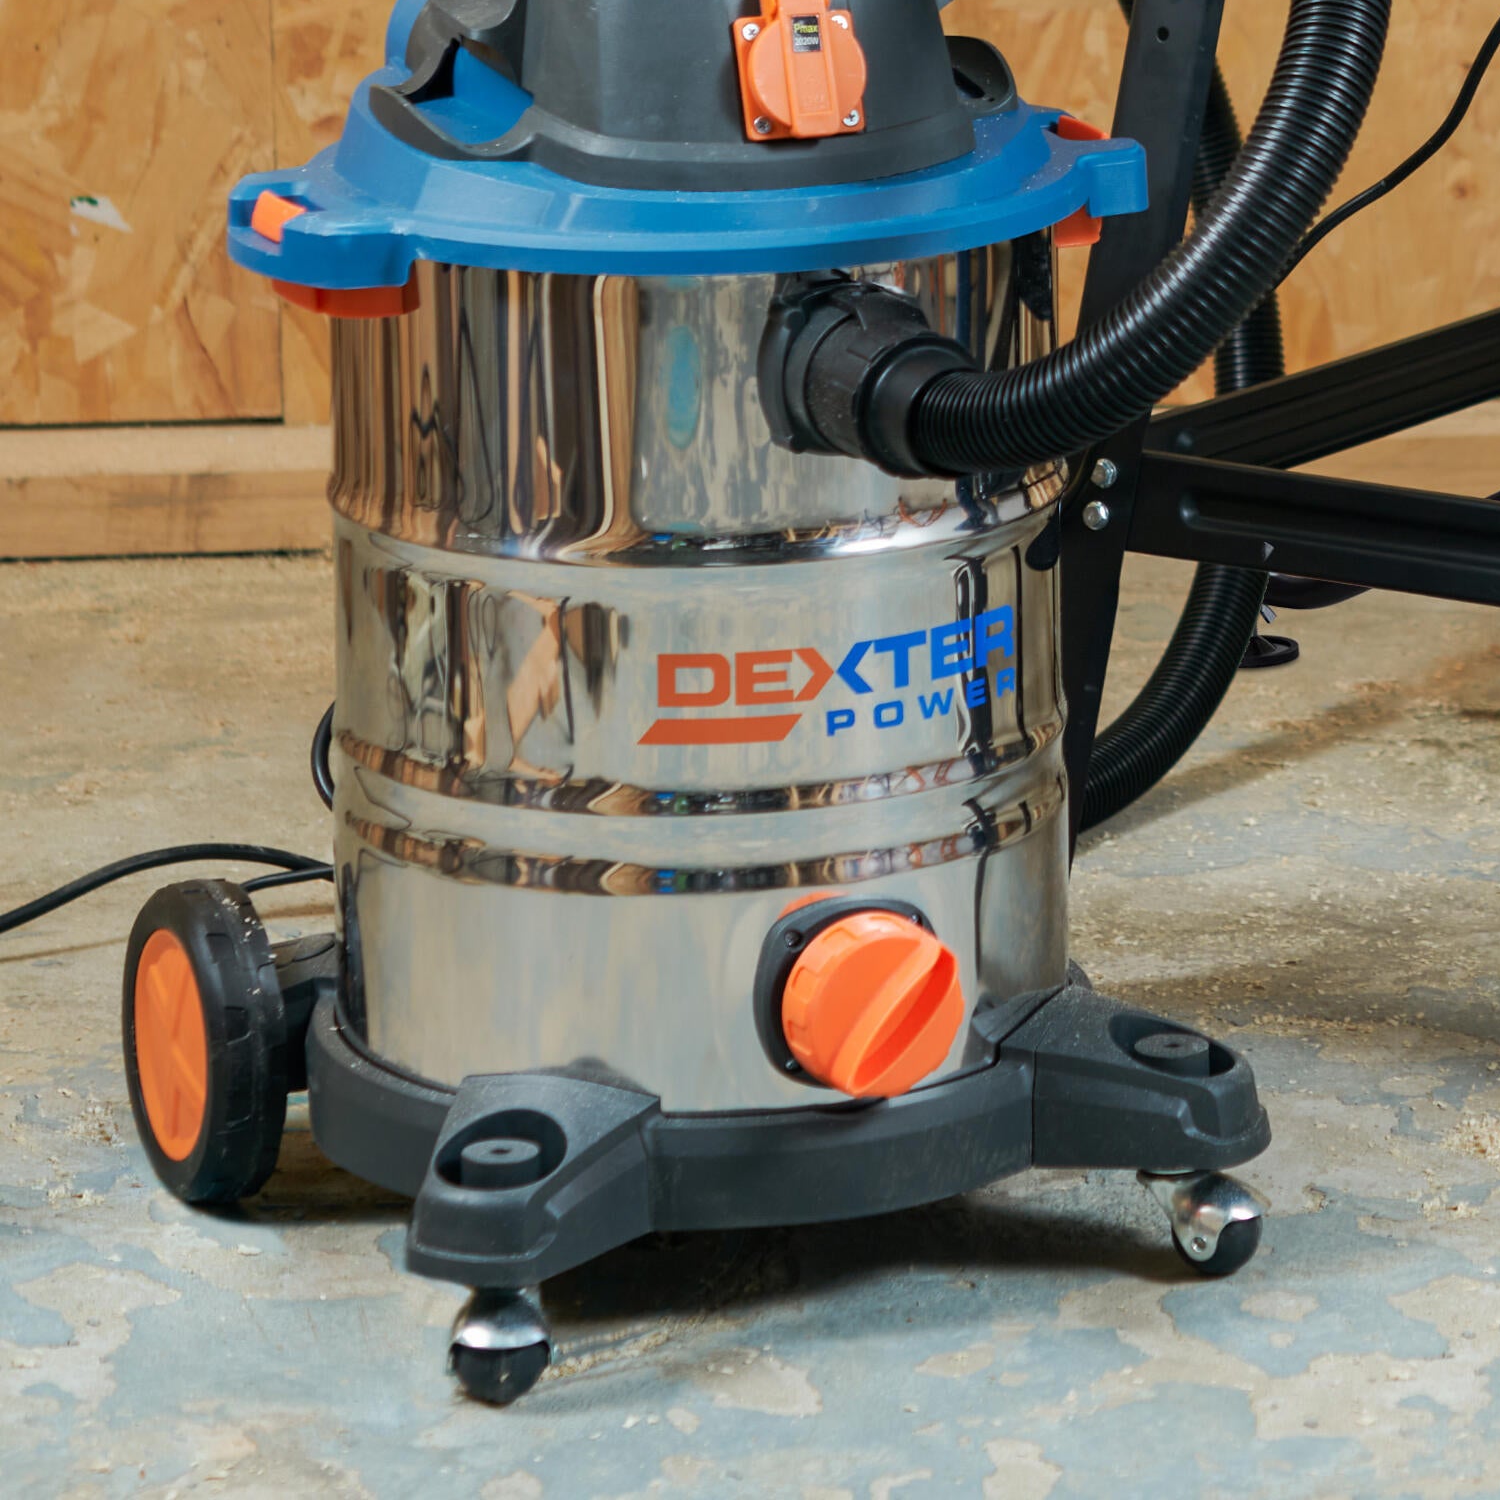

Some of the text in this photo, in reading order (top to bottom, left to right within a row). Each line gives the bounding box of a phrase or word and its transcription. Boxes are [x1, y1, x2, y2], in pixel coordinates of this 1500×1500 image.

[793, 23, 819, 34] Pmax
[656, 604, 1015, 708] DEXTER
[826, 666, 1016, 737] POWER
